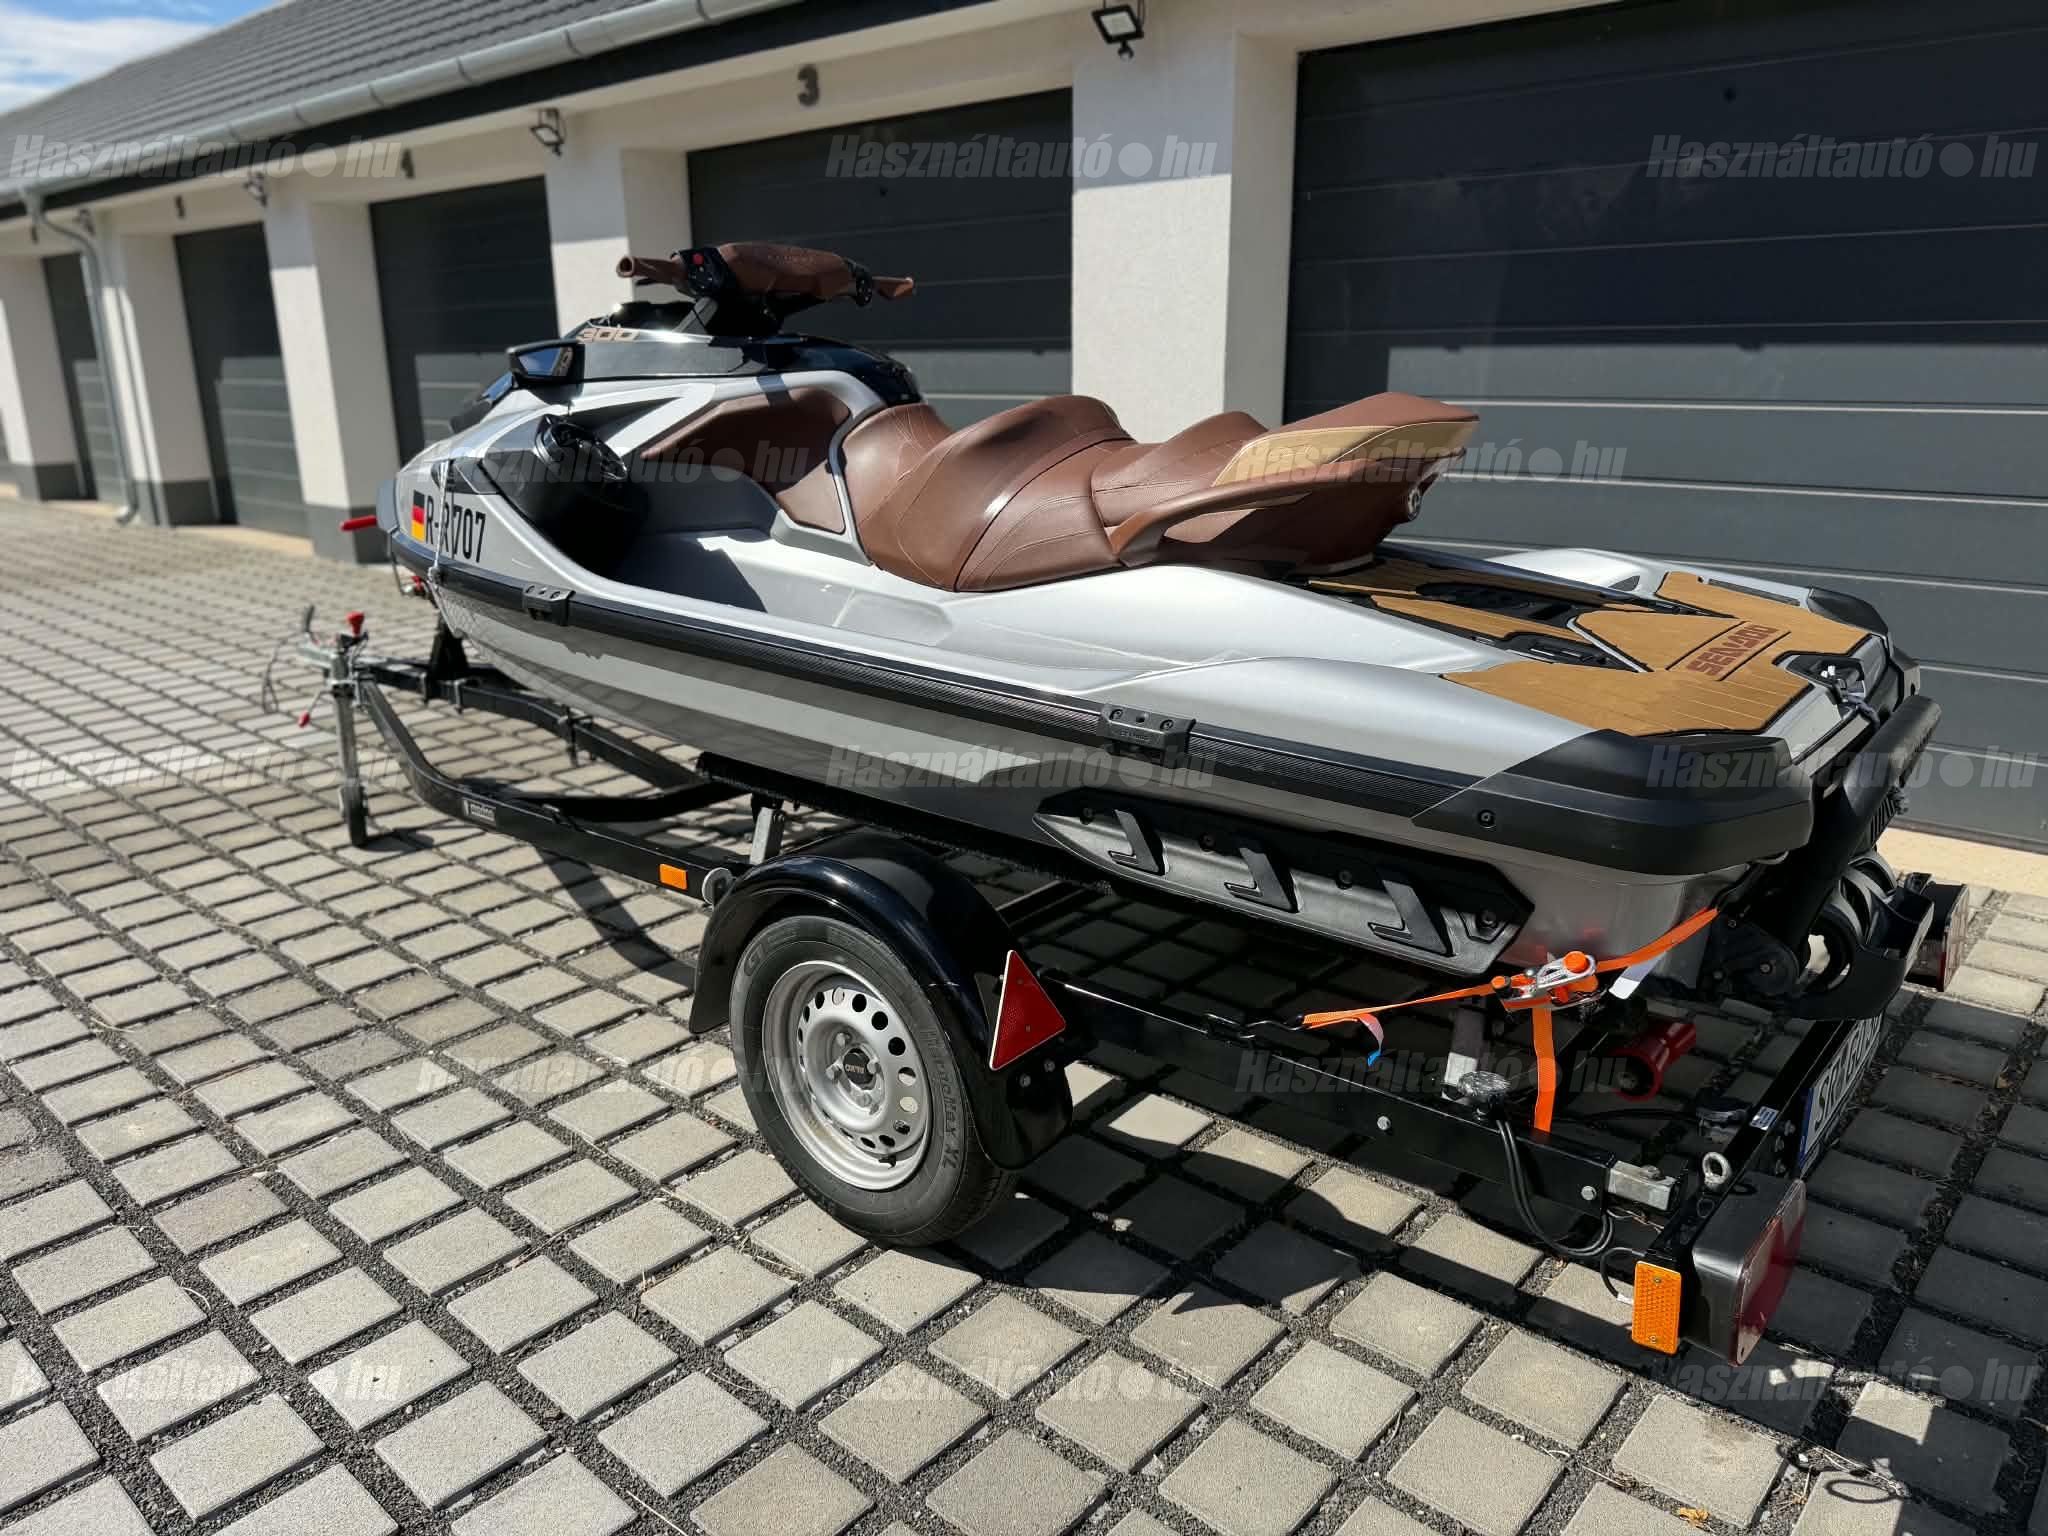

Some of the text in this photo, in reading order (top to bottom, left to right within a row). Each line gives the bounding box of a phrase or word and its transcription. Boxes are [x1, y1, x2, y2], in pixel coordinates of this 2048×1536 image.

[797, 65, 820, 107] 3
[577, 328, 639, 344] 300
[426, 495, 486, 563] R-R707
